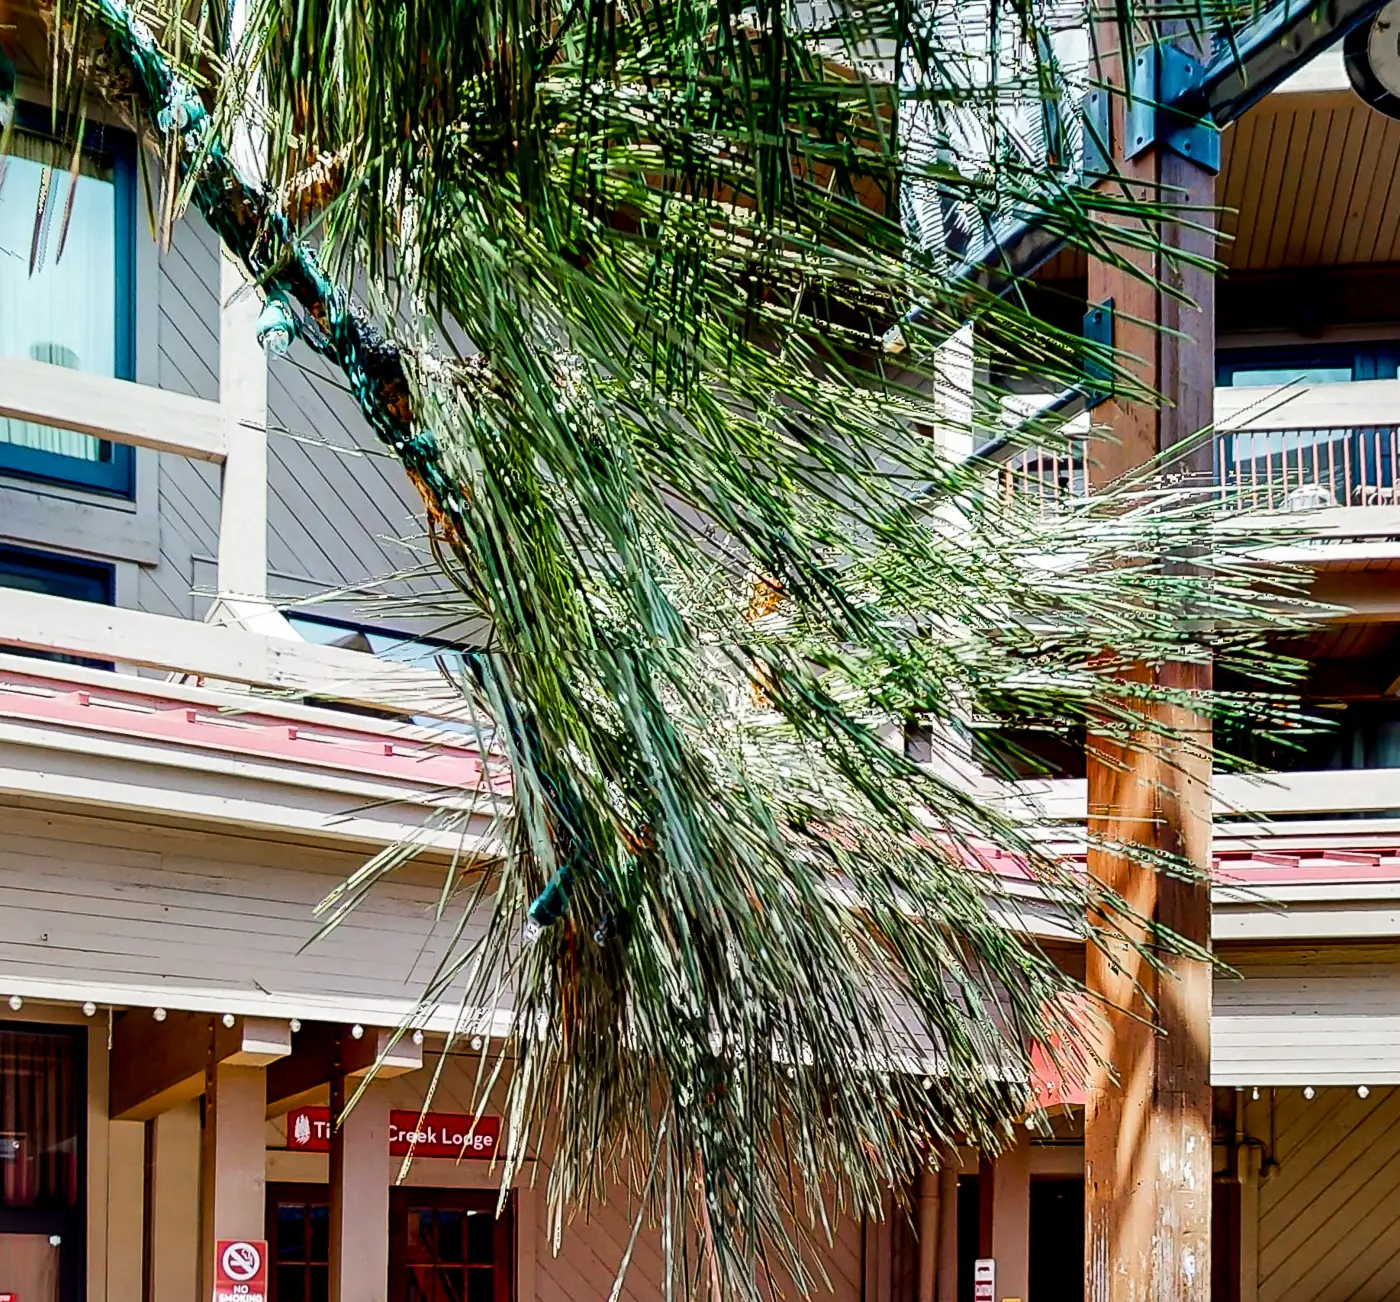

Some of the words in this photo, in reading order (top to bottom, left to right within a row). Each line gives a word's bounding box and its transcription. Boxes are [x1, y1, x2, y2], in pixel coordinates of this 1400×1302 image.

[389, 1124, 437, 1144] Creek
[442, 1127, 493, 1150] Lodge
[233, 1284, 249, 1294] NO
[218, 1293, 263, 1302] SMOKING
